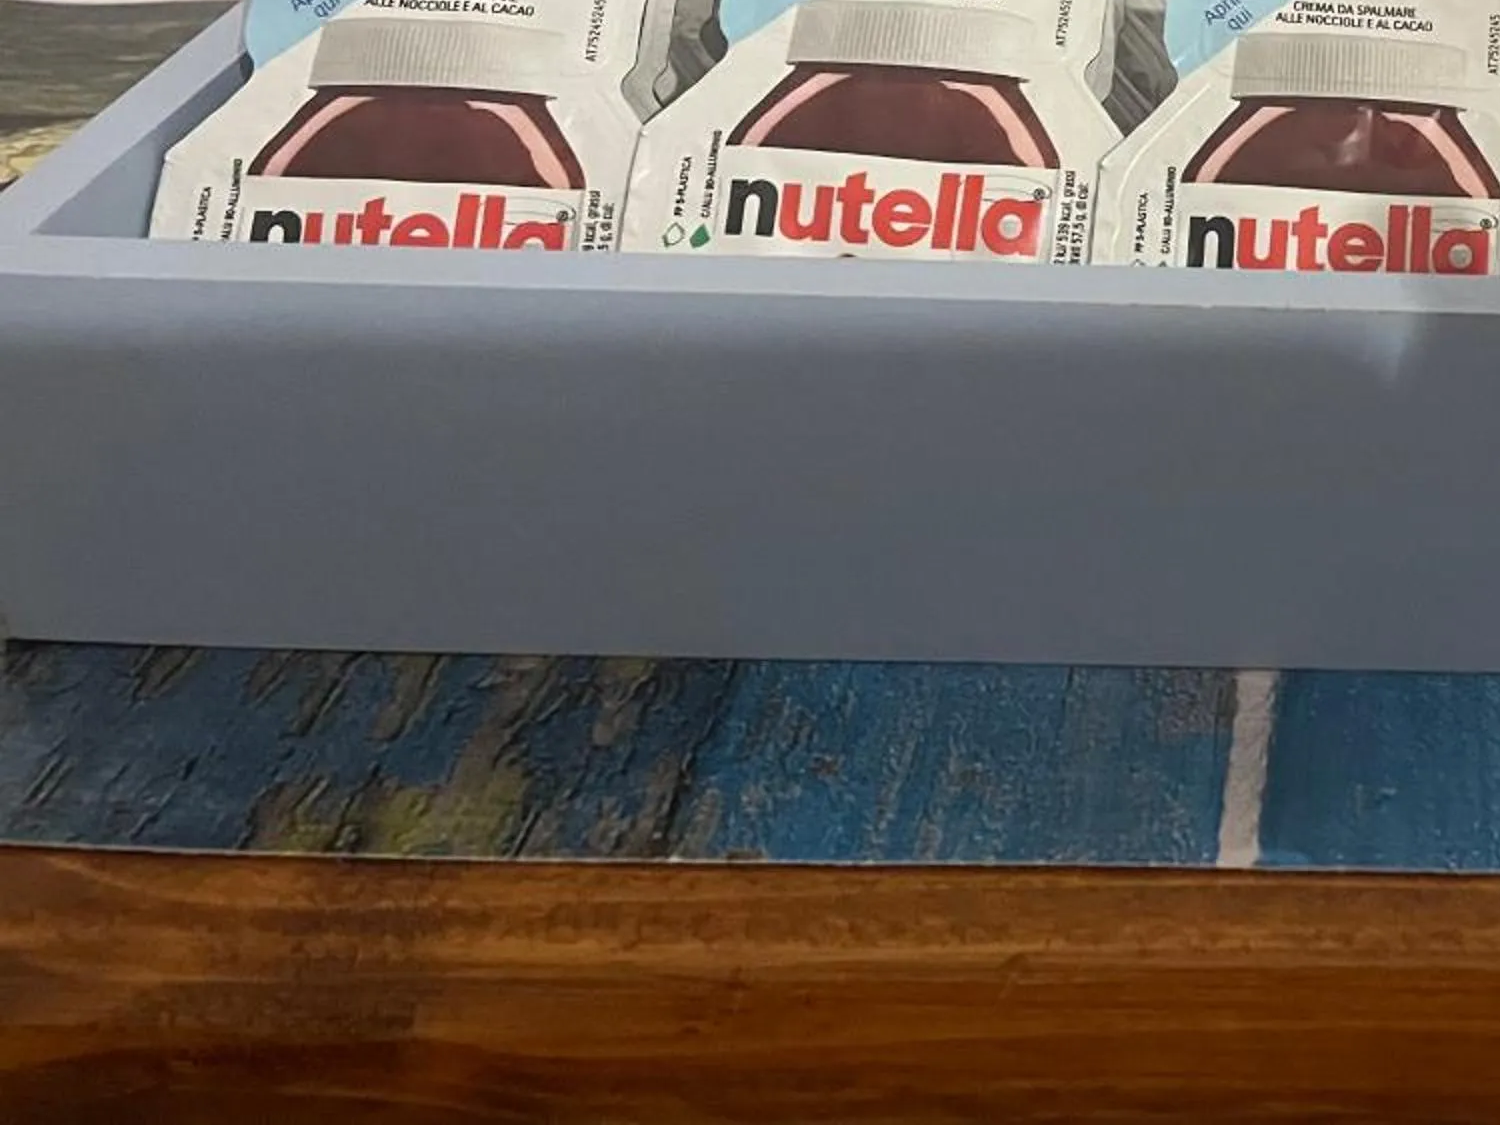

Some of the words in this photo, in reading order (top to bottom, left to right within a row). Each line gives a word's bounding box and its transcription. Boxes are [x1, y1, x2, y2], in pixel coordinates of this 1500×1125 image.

[473, 2, 489, 15] AL
[491, 3, 536, 18] CACAO
[1226, 9, 1254, 32] qui
[1293, 0, 1334, 14] CREMA
[1336, 2, 1354, 15] DA
[1356, 4, 1417, 19] SPALMARE
[1275, 12, 1304, 26] ALLE
[1306, 14, 1364, 29] NOCCIOLE
[1375, 18, 1391, 31] AL
[1392, 20, 1434, 34] CACAO
[249, 192, 566, 251] nutella
[724, 171, 1043, 257] nutella
[1187, 204, 1490, 275] nutella
